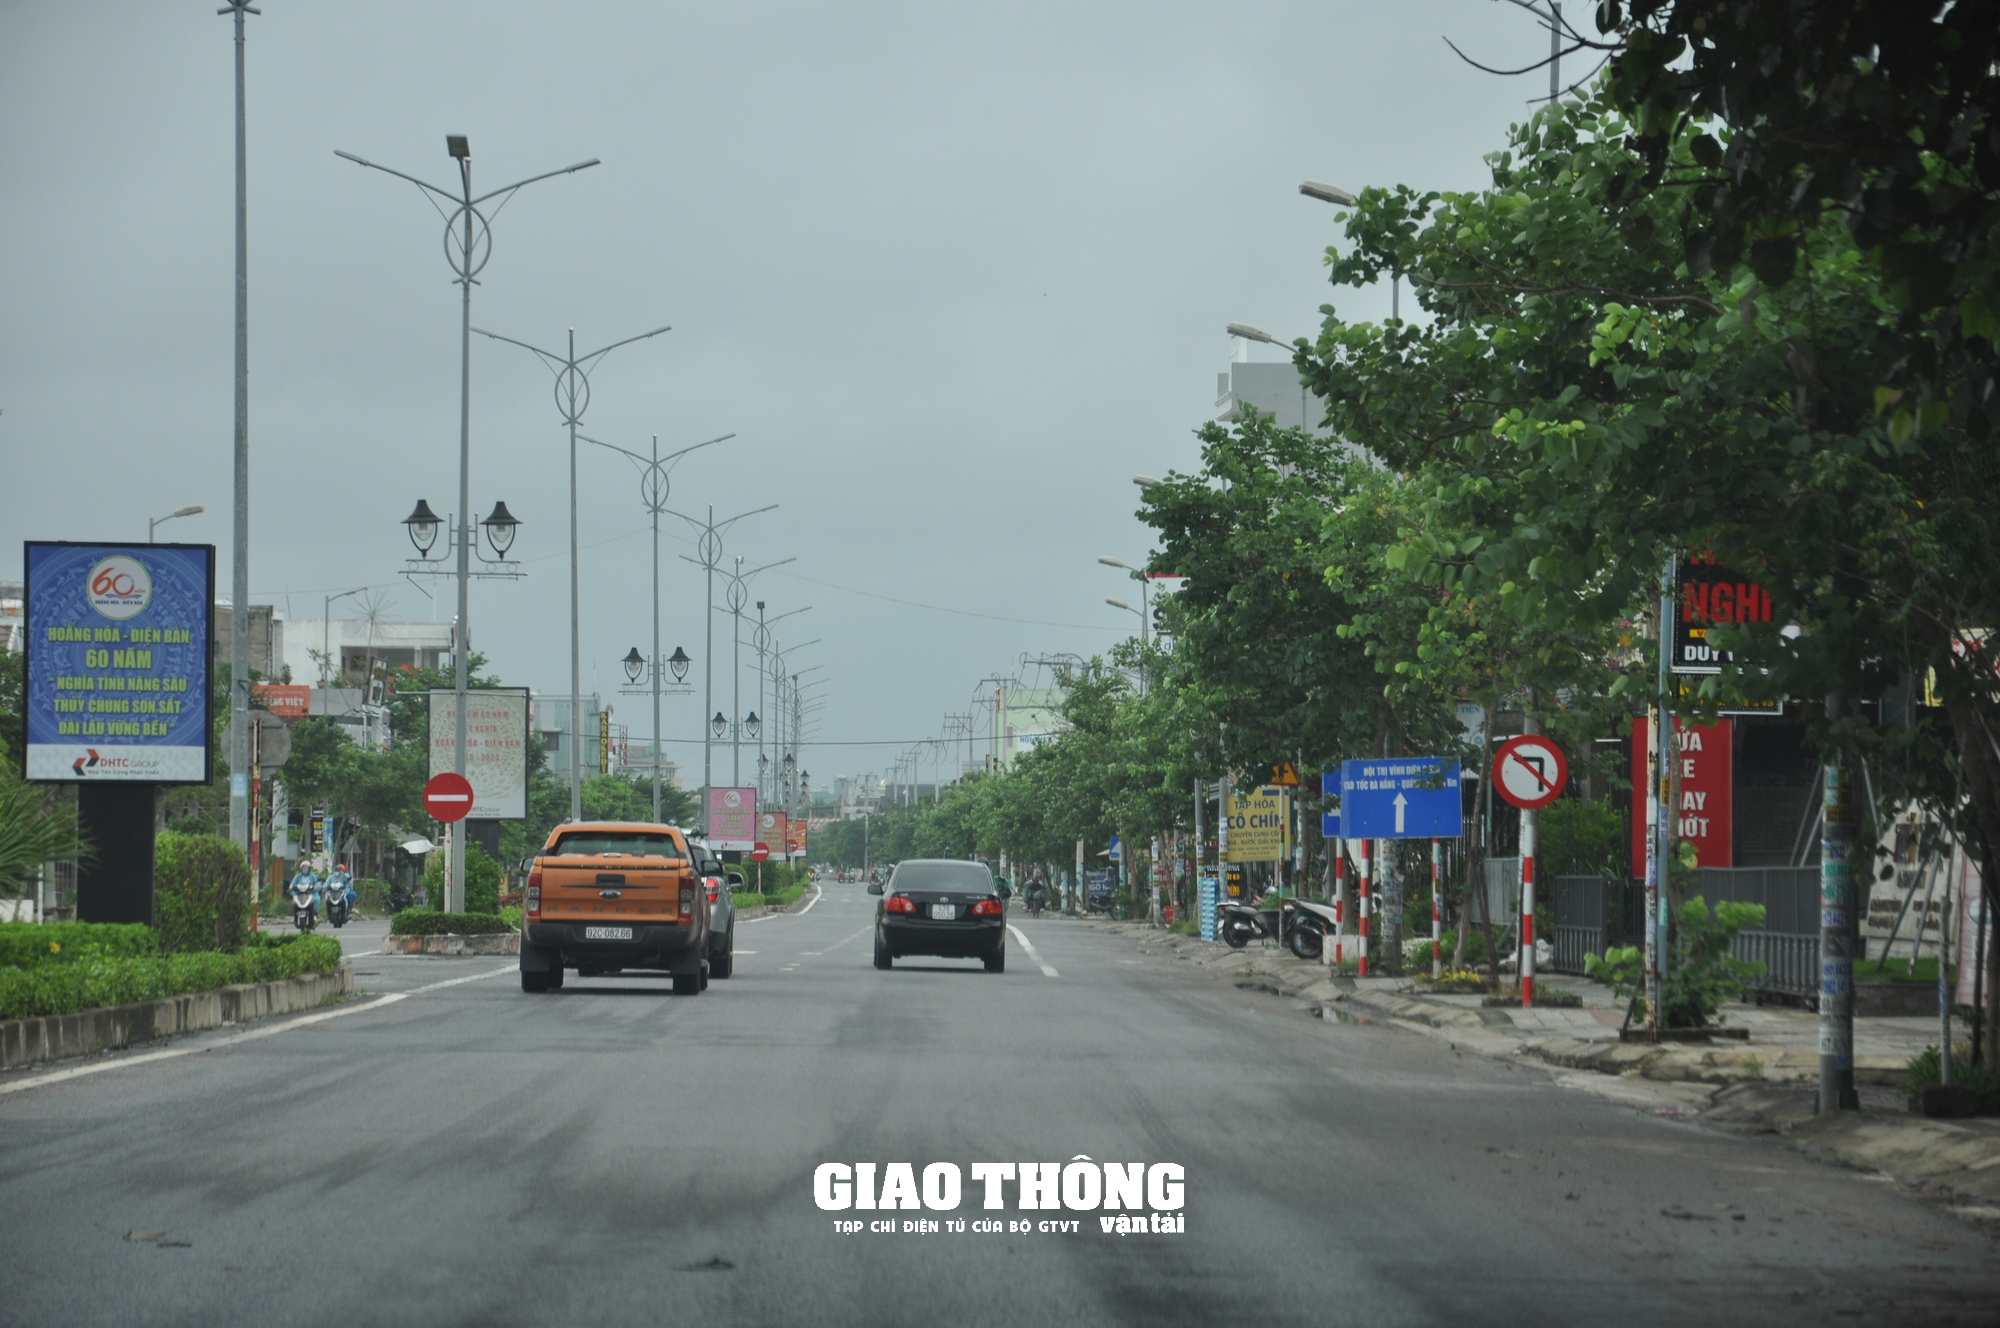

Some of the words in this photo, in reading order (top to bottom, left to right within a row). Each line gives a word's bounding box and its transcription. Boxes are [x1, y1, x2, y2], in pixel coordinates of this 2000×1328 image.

[92, 567, 135, 596] 60
[48, 623, 92, 642] HOẰNG
[94, 625, 120, 643] HÓA
[130, 625, 161, 647] ĐIỆN
[163, 626, 190, 644] BÀN
[85, 649, 109, 668] 60
[113, 646, 152, 670] NĂM
[97, 675, 125, 691] TÌNH
[128, 676, 160, 694] NẶNG
[163, 675, 187, 692] SÂU
[53, 695, 85, 713] THỦY
[88, 698, 129, 713] CHUNG
[158, 696, 182, 714] SẮT
[58, 718, 79, 735] DÀI
[82, 719, 105, 735] LÂU
[107, 718, 140, 736] VỮNG
[467, 738, 478, 747] ÓA
[1677, 725, 1703, 751] ỬA
[100, 758, 129, 768] DHTC
[130, 760, 160, 768] GROUP
[481, 753, 500, 761] 2023
[1363, 765, 1375, 778] NỘI
[1377, 766, 1388, 778] THỊ
[1389, 764, 1405, 776] VĨNH
[1356, 778, 1369, 791] TỐC
[1369, 778, 1379, 791] ĐÀ
[1234, 800, 1252, 812] TẠP
[1254, 799, 1276, 809] HÓA
[1227, 812, 1246, 829] CÔ
[1254, 830, 1270, 838] CUNG
[547, 906, 672, 914] RANGER
